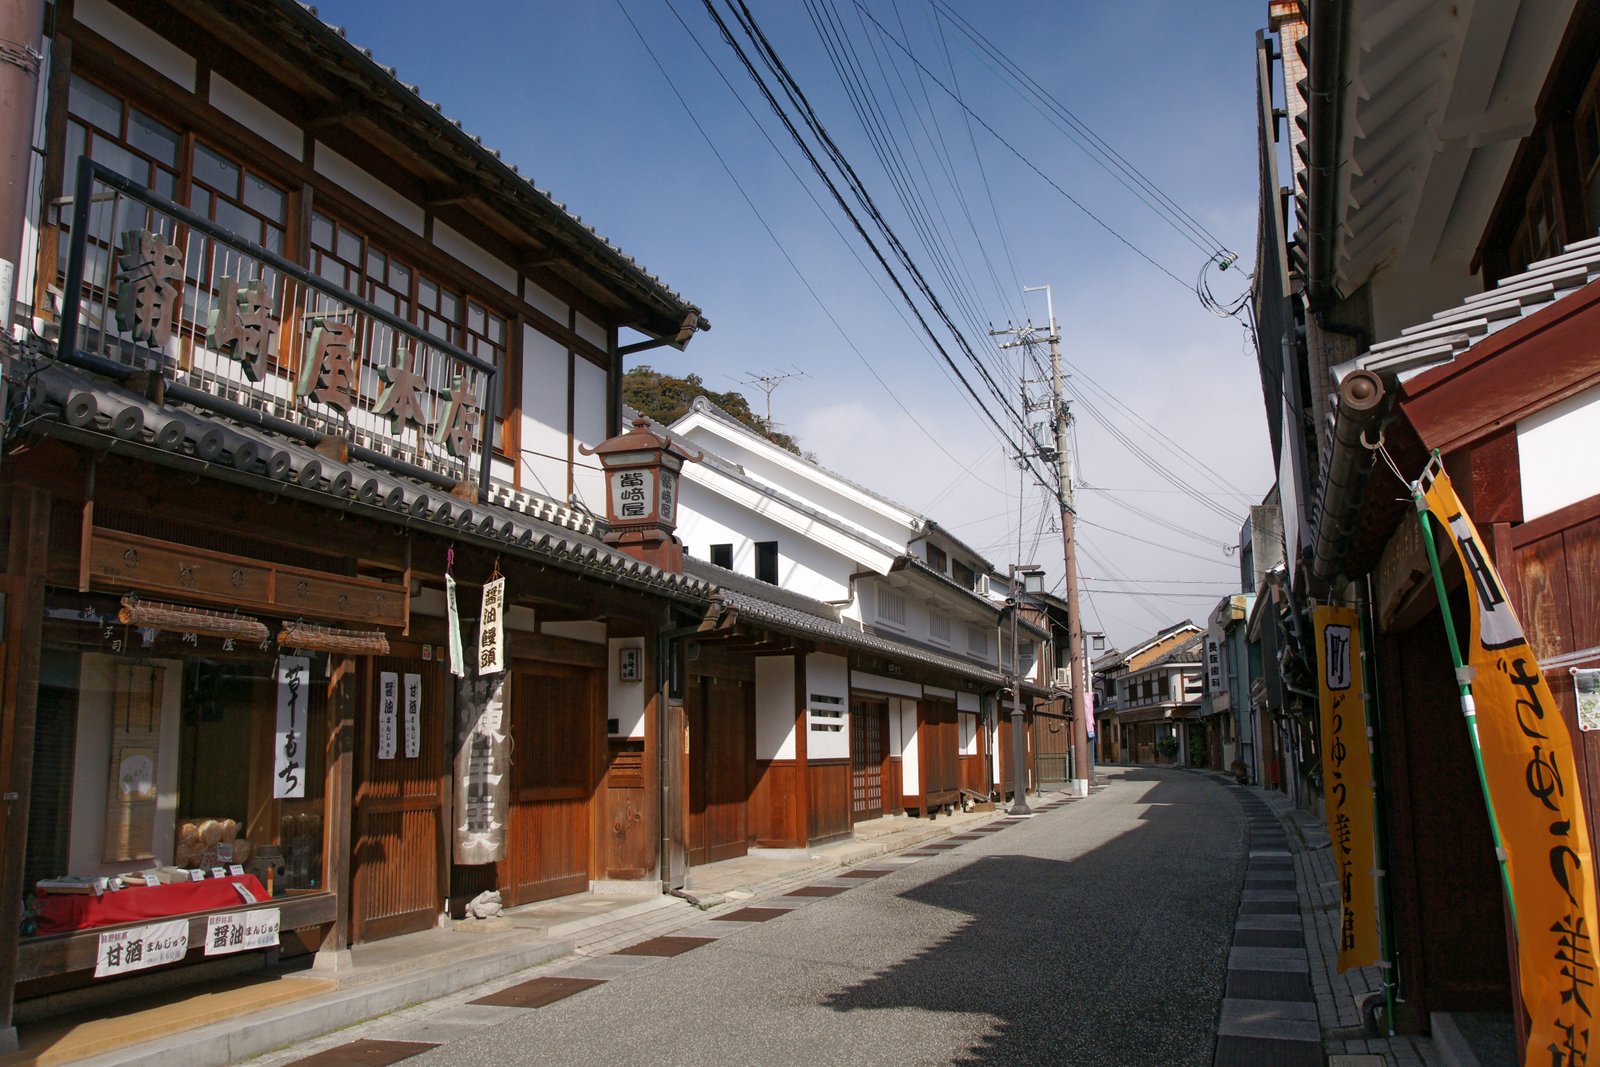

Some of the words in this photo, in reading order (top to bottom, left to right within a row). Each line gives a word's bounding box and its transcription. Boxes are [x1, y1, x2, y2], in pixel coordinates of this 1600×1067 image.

[481, 586, 498, 668] 醤油饅頭
[278, 664, 304, 795] 草もち
